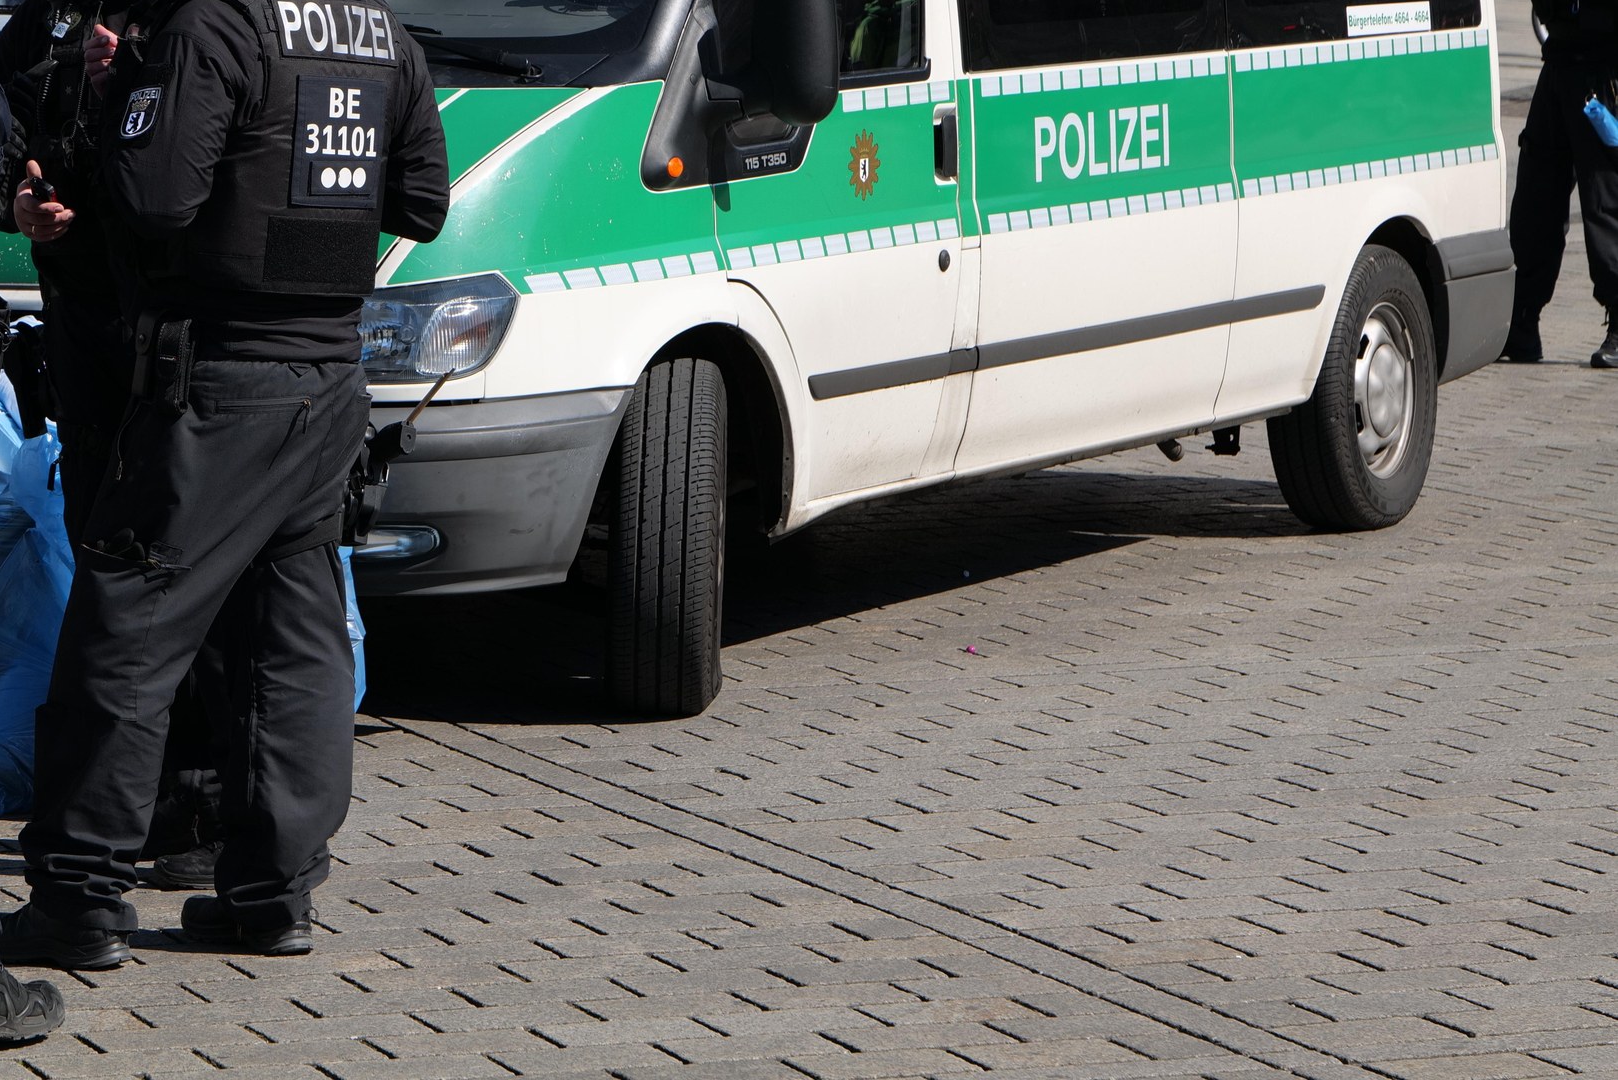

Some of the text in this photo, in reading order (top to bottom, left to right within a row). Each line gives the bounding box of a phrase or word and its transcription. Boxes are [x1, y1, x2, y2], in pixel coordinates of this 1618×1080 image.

[276, 0, 396, 61] POLIZEI
[1348, 12, 1394, 30] Bürgertelefon:
[1394, 11, 1409, 25] 4664
[1414, 9, 1429, 24] 4664
[328, 87, 362, 120] BE
[305, 123, 377, 158] 31101
[1034, 103, 1170, 183] POLIZEI
[745, 152, 787, 170] 115 T350
